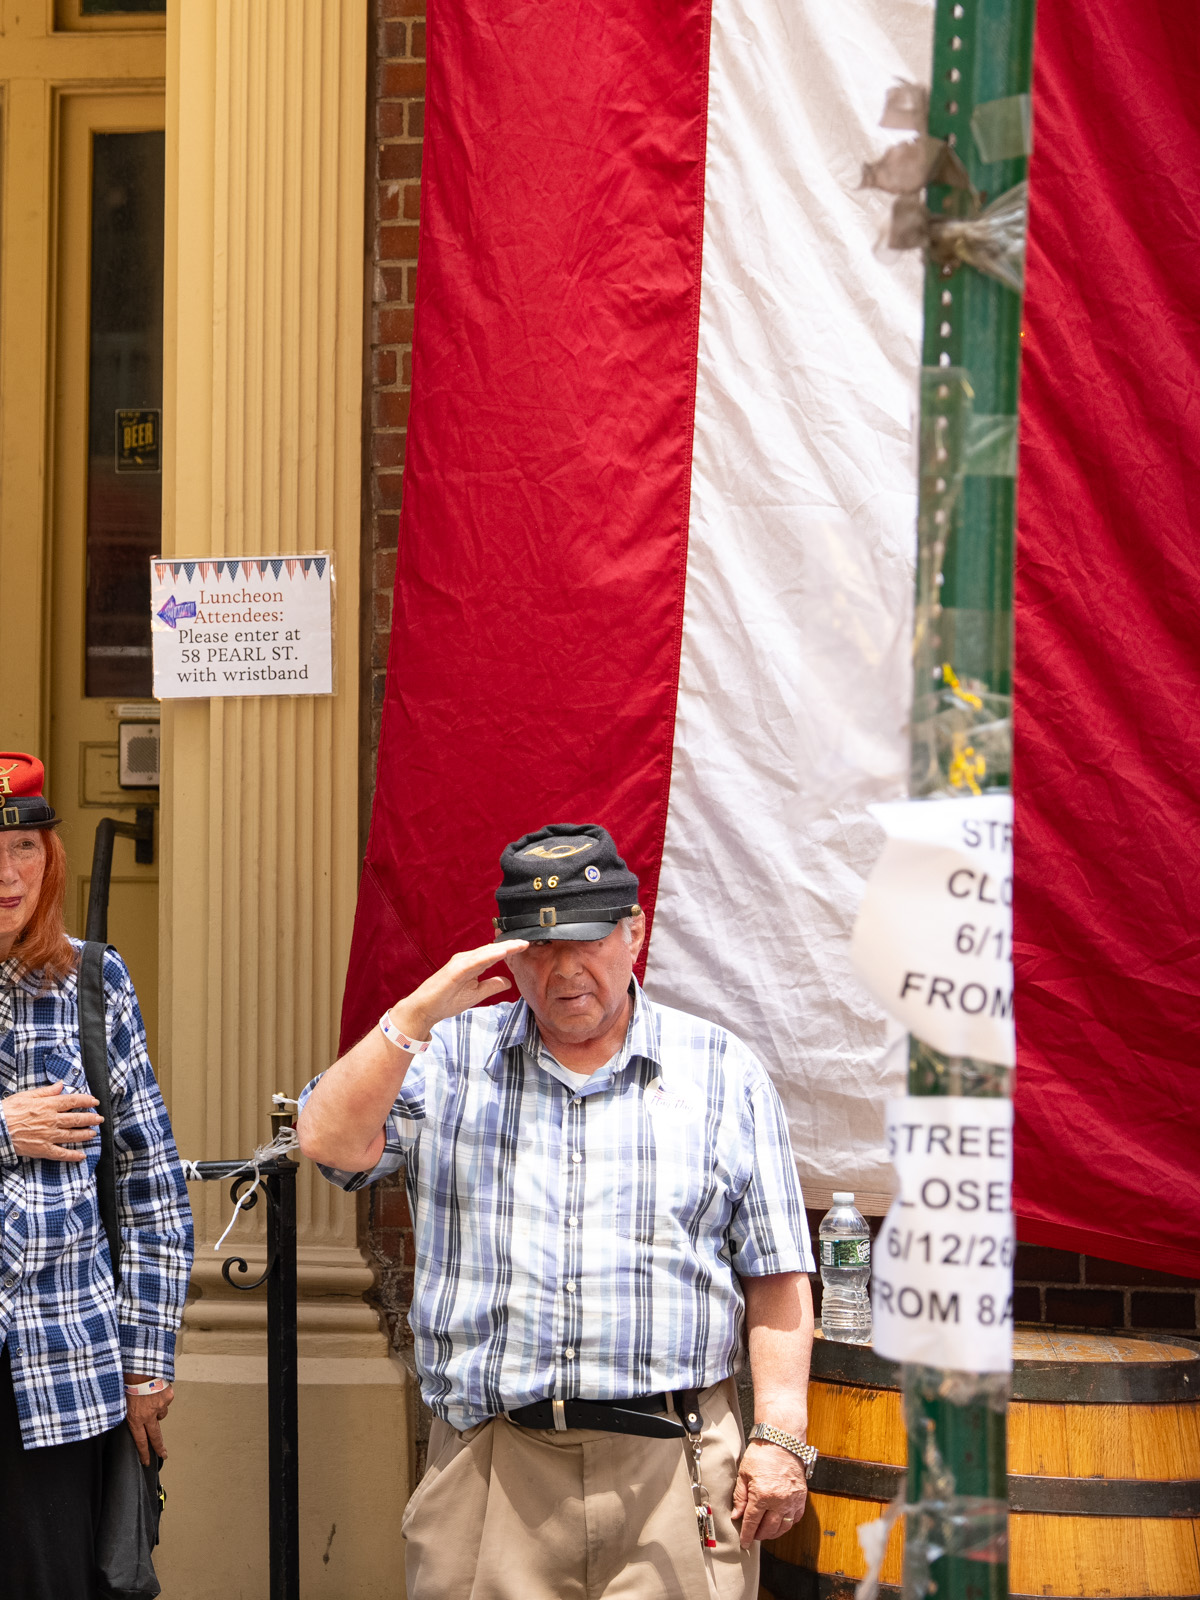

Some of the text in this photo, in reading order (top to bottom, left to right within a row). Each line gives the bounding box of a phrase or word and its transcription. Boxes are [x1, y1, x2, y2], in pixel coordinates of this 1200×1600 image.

[123, 423, 154, 449] BEER
[200, 588, 284, 605] Luncheon
[193, 608, 284, 624] Attendees:
[178, 628, 301, 644] Please enter at
[181, 646, 298, 663] 58 PEARL ST.
[177, 664, 309, 682] with wristband
[955, 923, 1013, 962] 6/1
[899, 971, 1014, 1020] FROM
